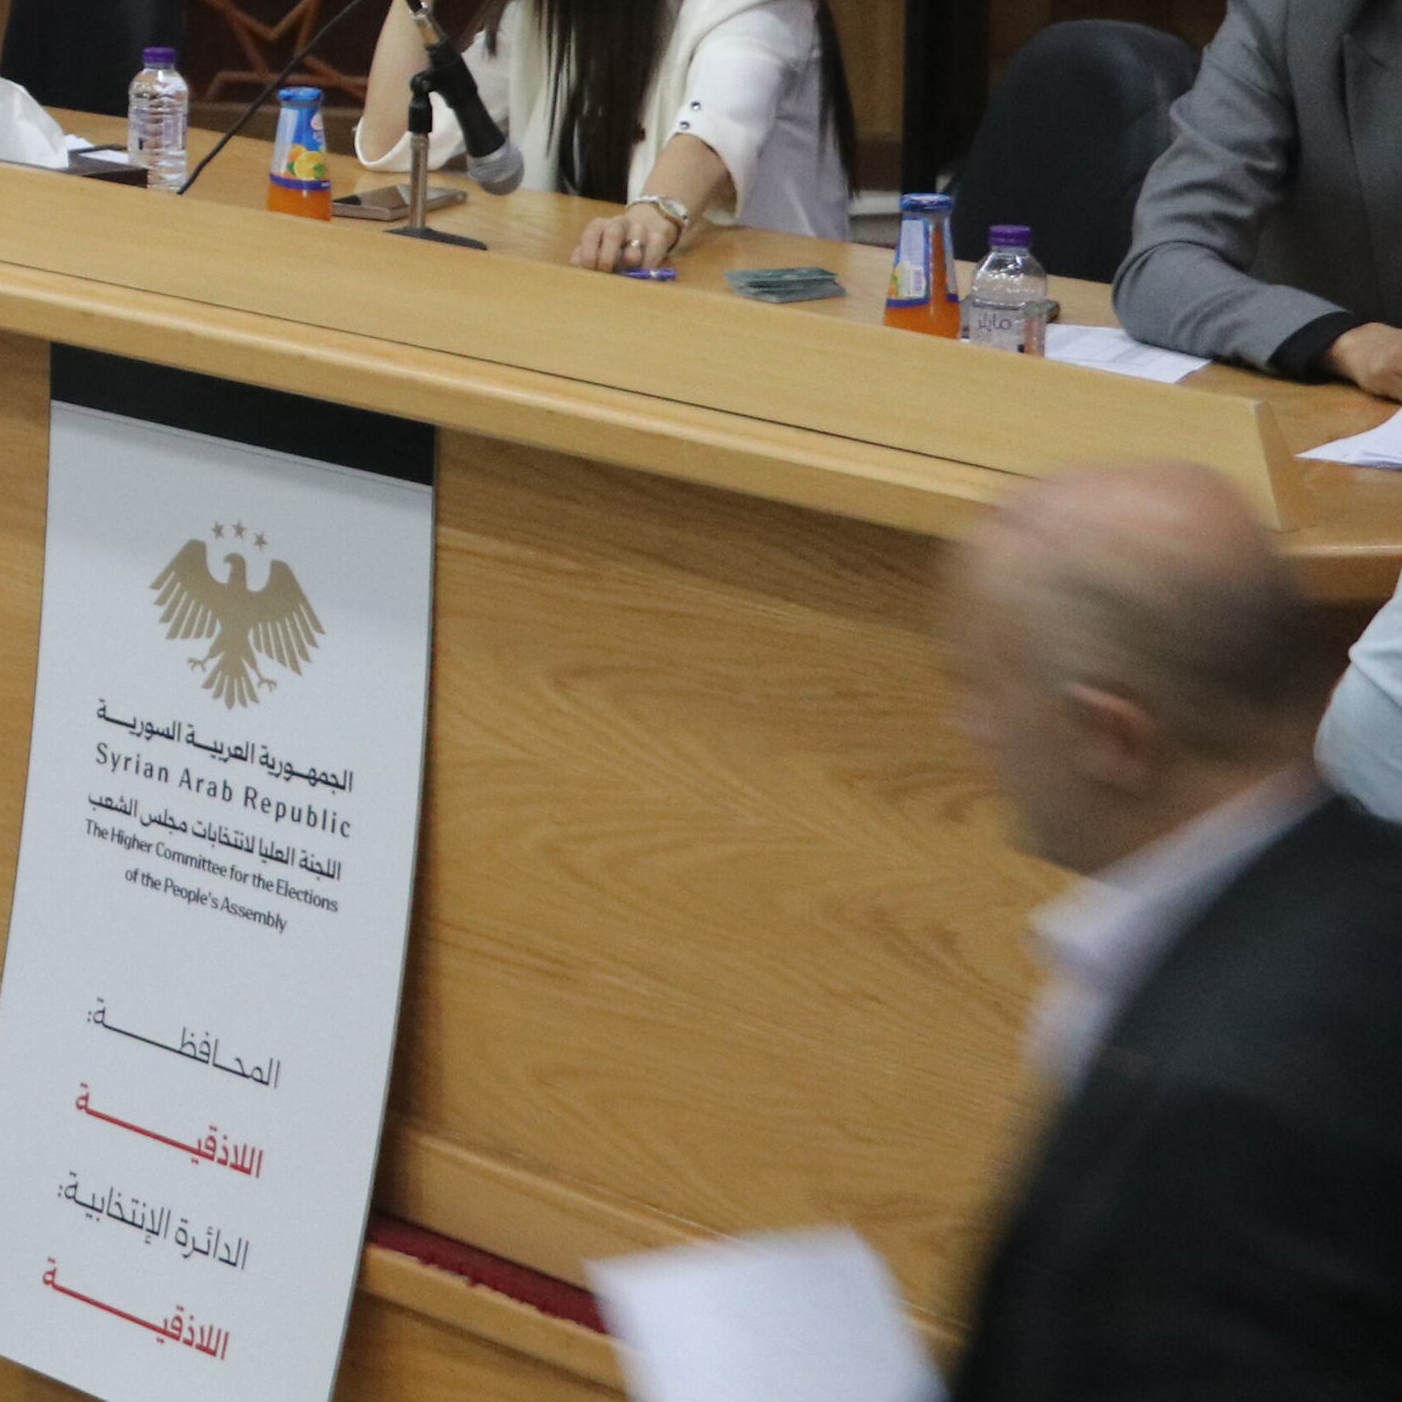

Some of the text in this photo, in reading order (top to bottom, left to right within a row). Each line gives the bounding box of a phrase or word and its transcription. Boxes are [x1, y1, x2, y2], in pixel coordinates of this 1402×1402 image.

[96, 698, 182, 742] السورية
[185, 723, 255, 763] العربية
[95, 741, 352, 839] Syrian Arab Republic
[85, 818, 339, 913] The Higher Committee for the Elections
[87, 793, 342, 881] اللجنة العليا لانتخابات مجلس الشعب
[124, 867, 288, 934] of the People's Assembly
[75, 1082, 264, 1179] اللاذقية
[174, 1217, 249, 1271] الدائرة
[41, 1257, 230, 1361] اللاذقية
